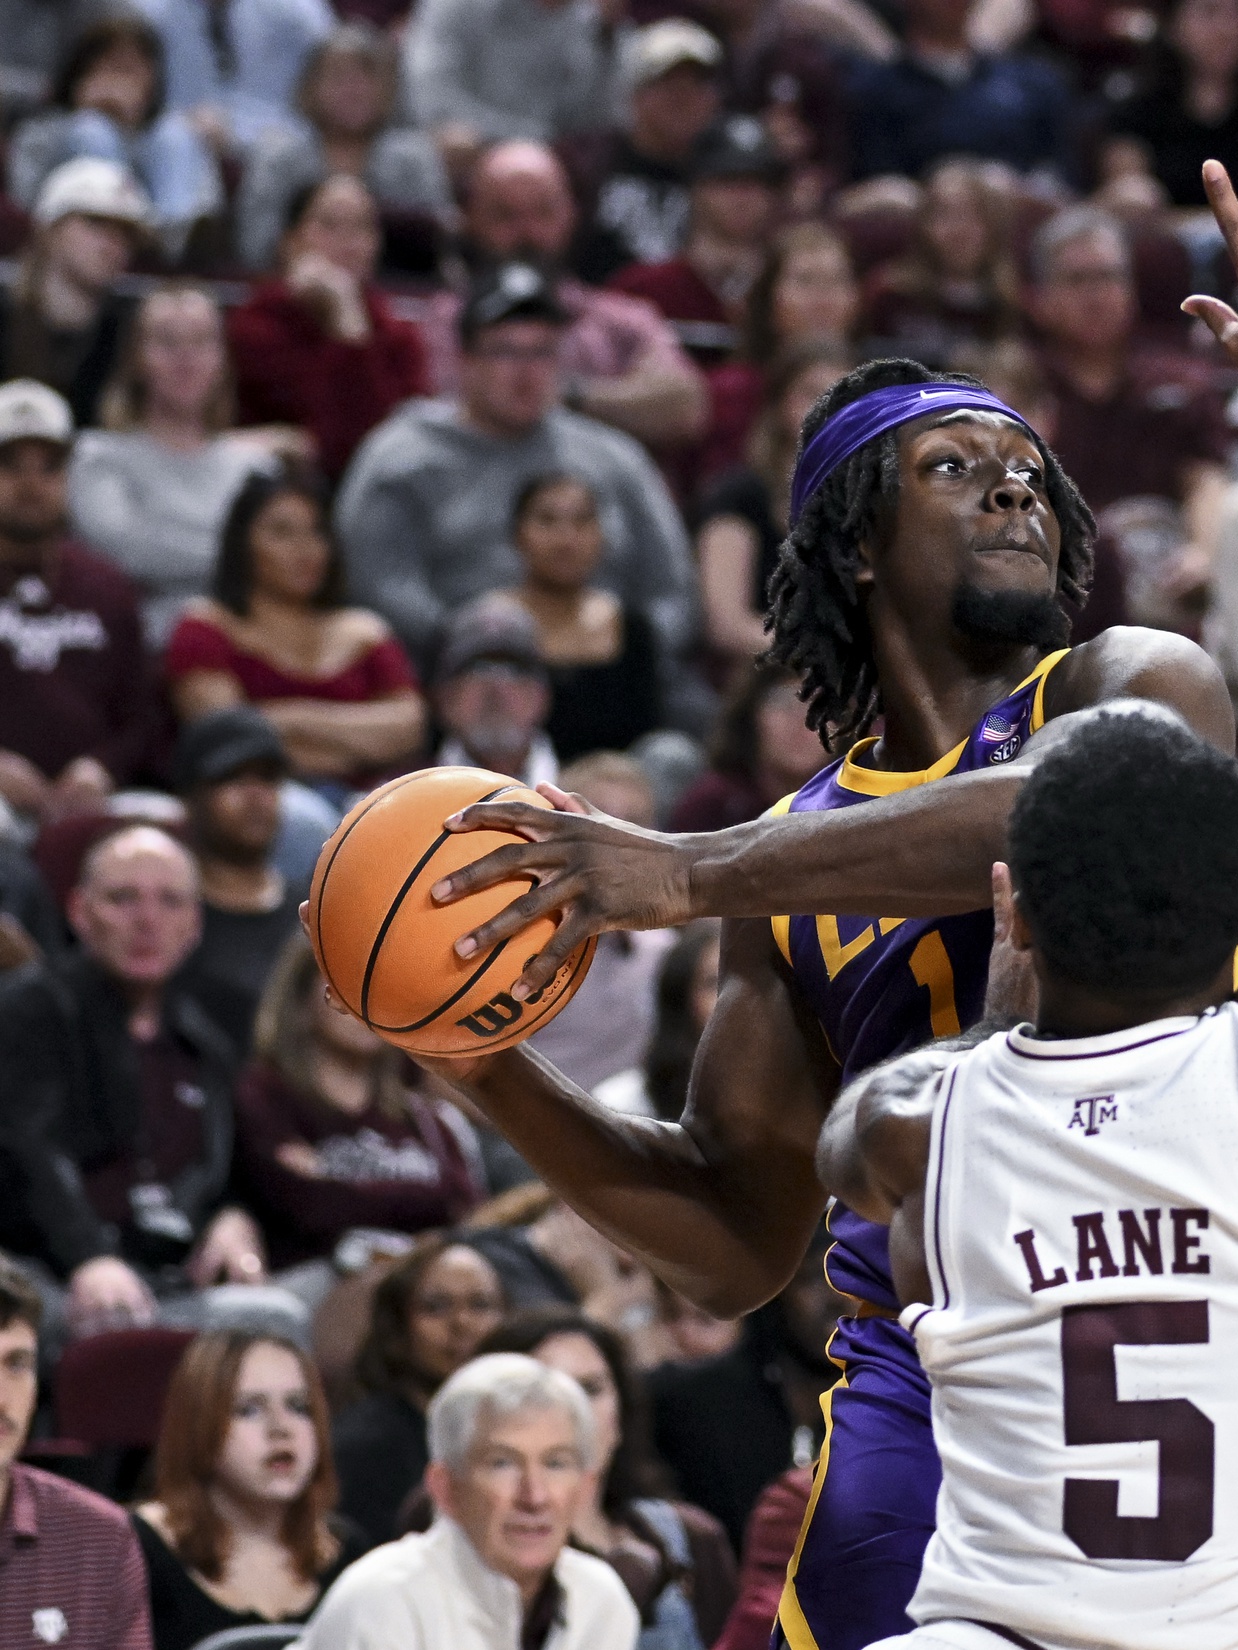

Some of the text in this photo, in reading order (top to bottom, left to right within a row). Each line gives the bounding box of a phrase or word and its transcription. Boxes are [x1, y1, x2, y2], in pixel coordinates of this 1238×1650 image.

[993, 737, 1018, 761] SEC
[908, 929, 961, 1038] 1
[1014, 1208, 1210, 1293] LANE
[1061, 1298, 1215, 1561] 5
